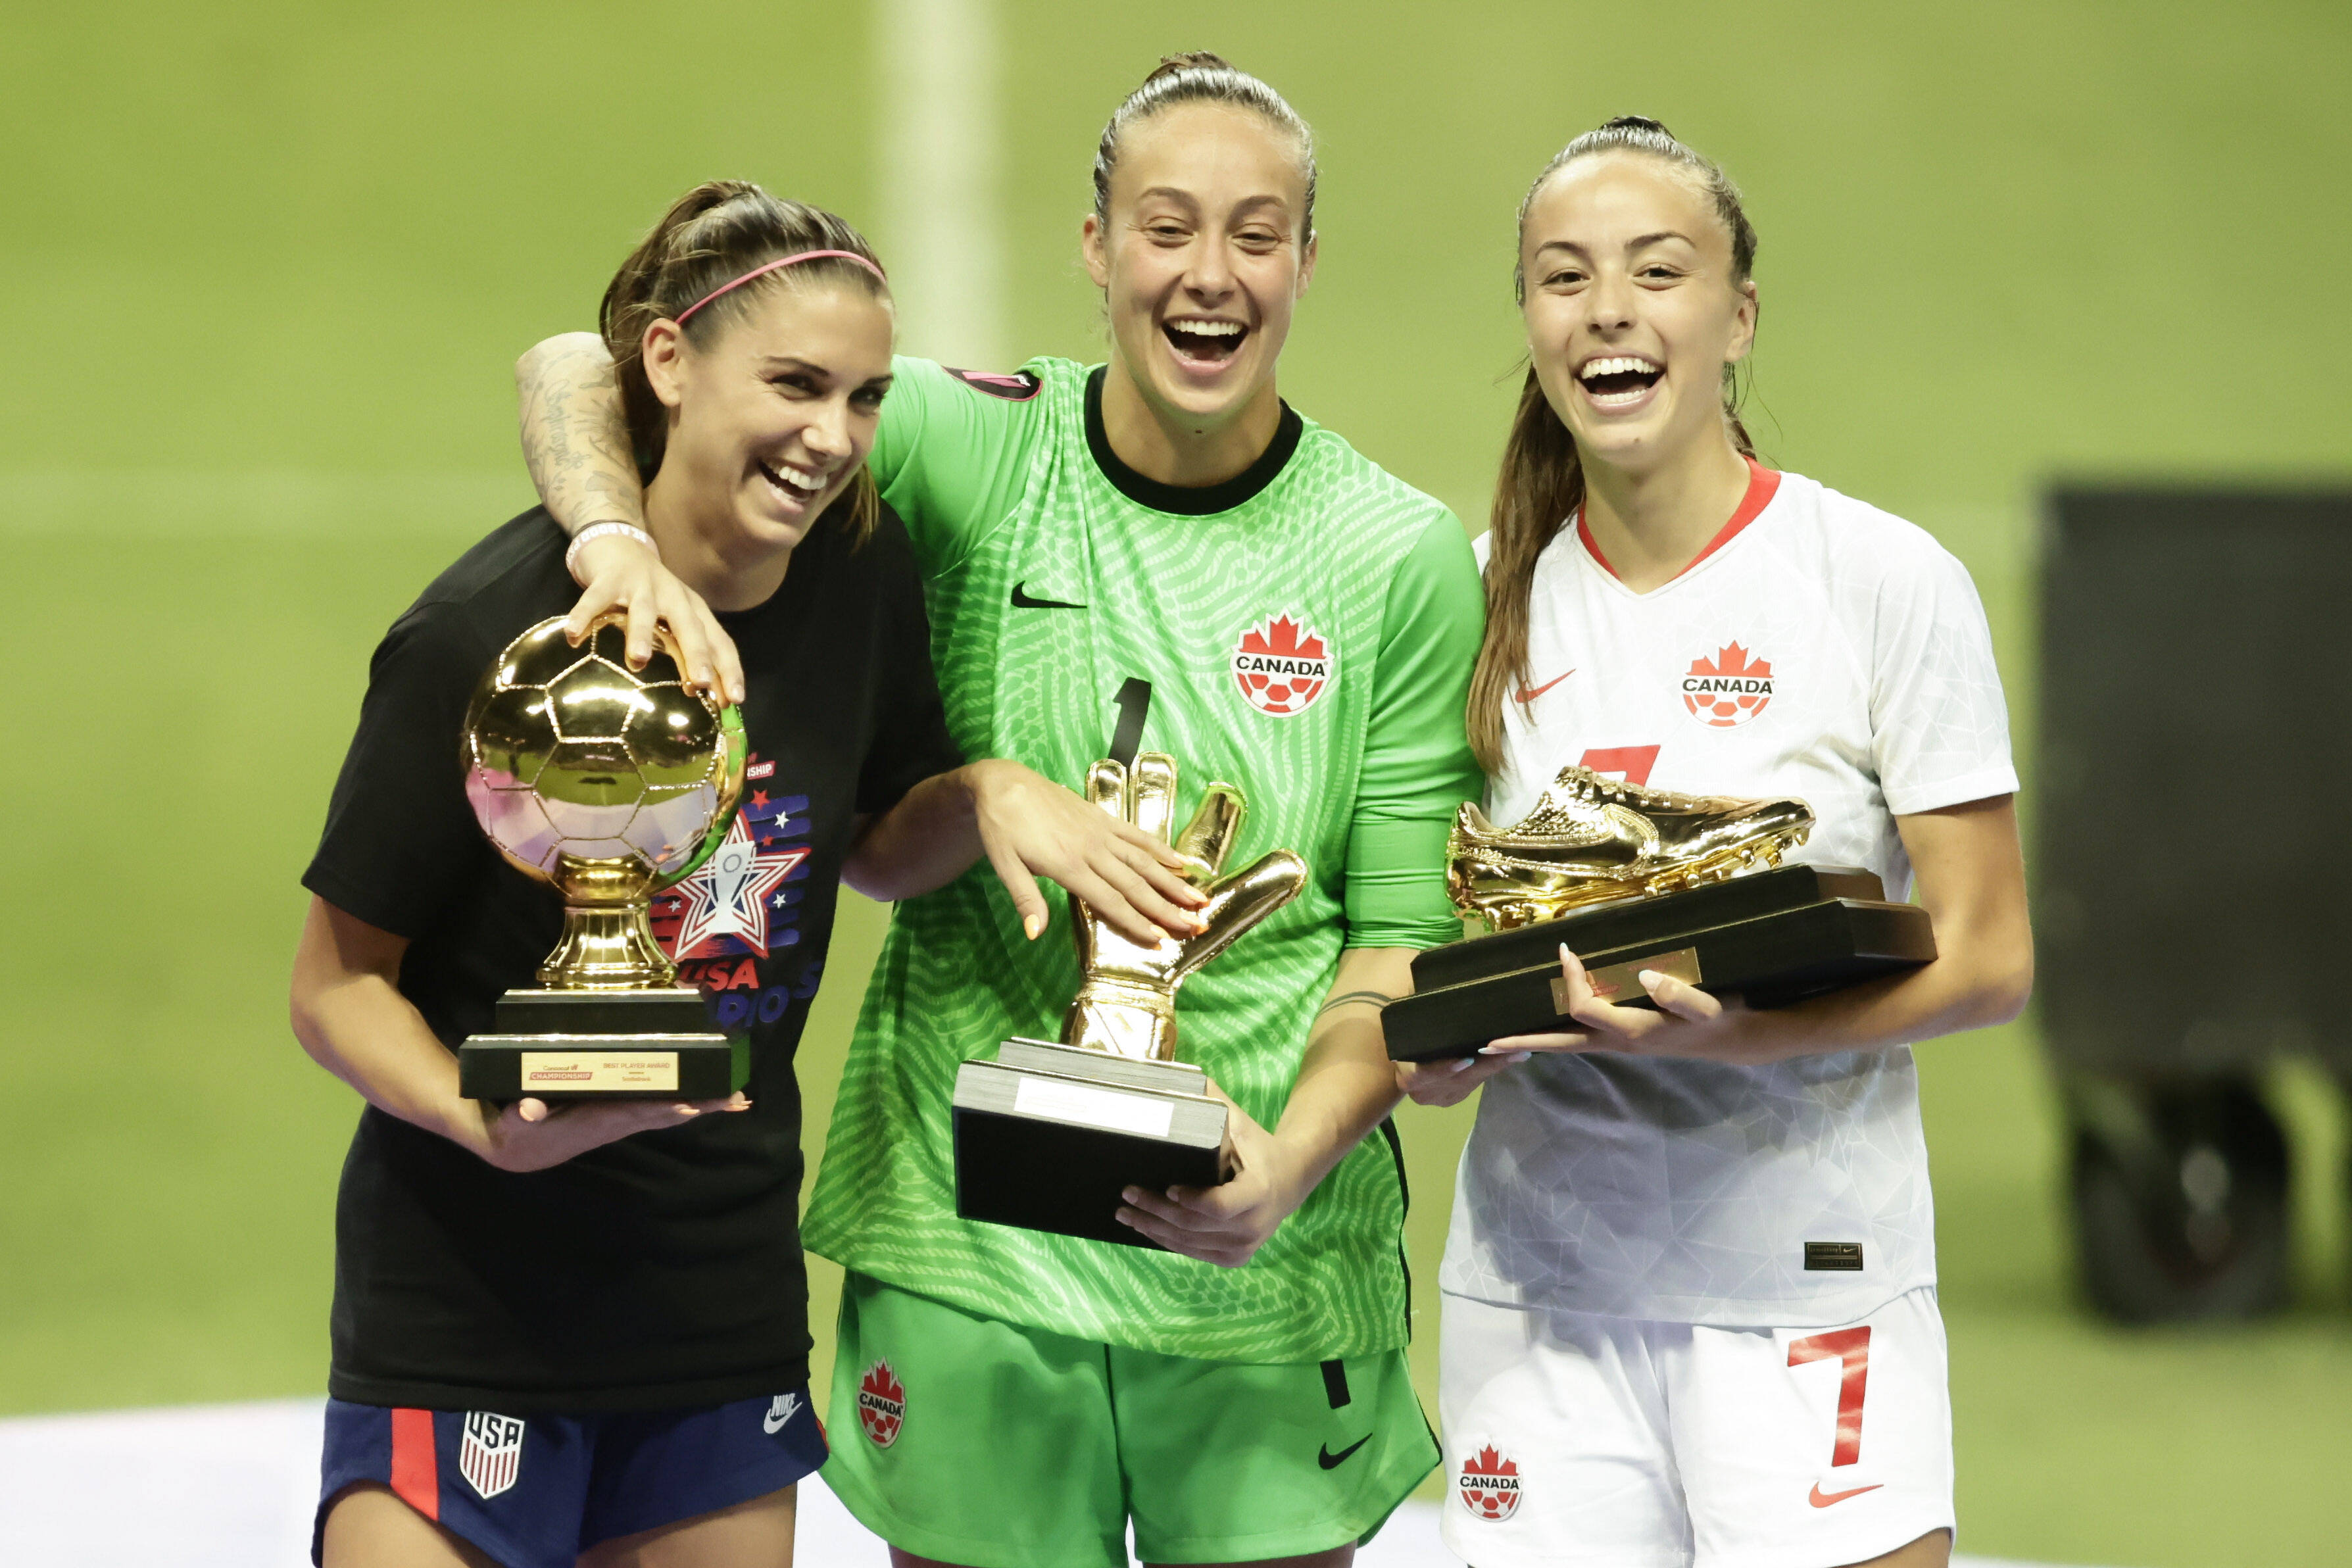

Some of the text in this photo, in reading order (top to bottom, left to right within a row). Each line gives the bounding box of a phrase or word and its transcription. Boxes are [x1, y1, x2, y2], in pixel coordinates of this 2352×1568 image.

[1236, 656, 1325, 677] CANADA
[1682, 678, 1773, 695] CANADA
[770, 1392, 795, 1417] NIKE
[859, 1393, 902, 1417] CANADA
[1786, 1325, 1871, 1467] 7
[468, 1412, 520, 1449] USA
[1459, 1476, 1519, 1490] CANADA
